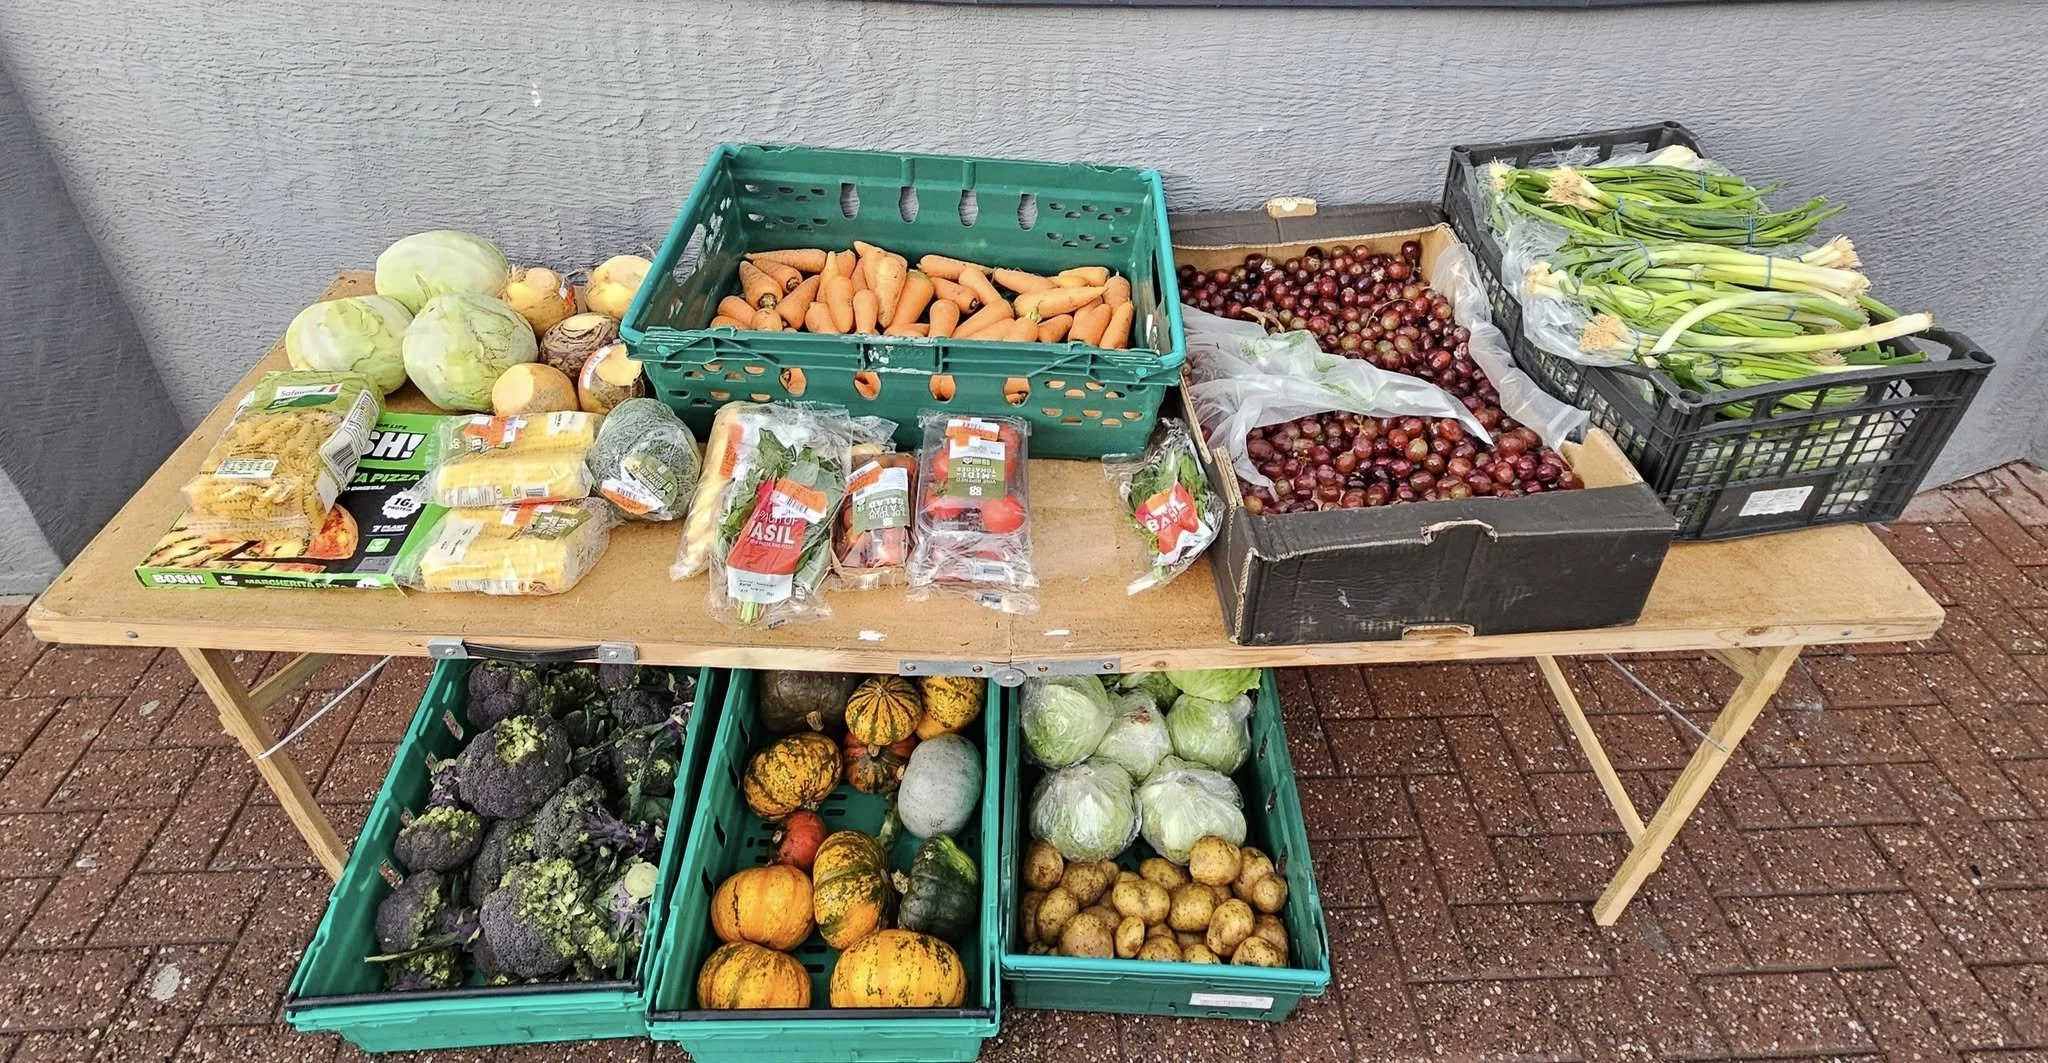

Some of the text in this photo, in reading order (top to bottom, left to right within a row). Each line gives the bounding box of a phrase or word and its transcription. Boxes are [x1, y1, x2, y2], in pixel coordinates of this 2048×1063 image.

[369, 473, 420, 483] PIZZA
[868, 497, 905, 508] SALAD
[869, 505, 888, 514] DAY
[869, 511, 889, 519] YOUR
[1146, 502, 1187, 533] BASIL
[748, 520, 795, 544] ASIL
[152, 574, 206, 584] BOSH!
[245, 579, 315, 588] MARGHERITA
